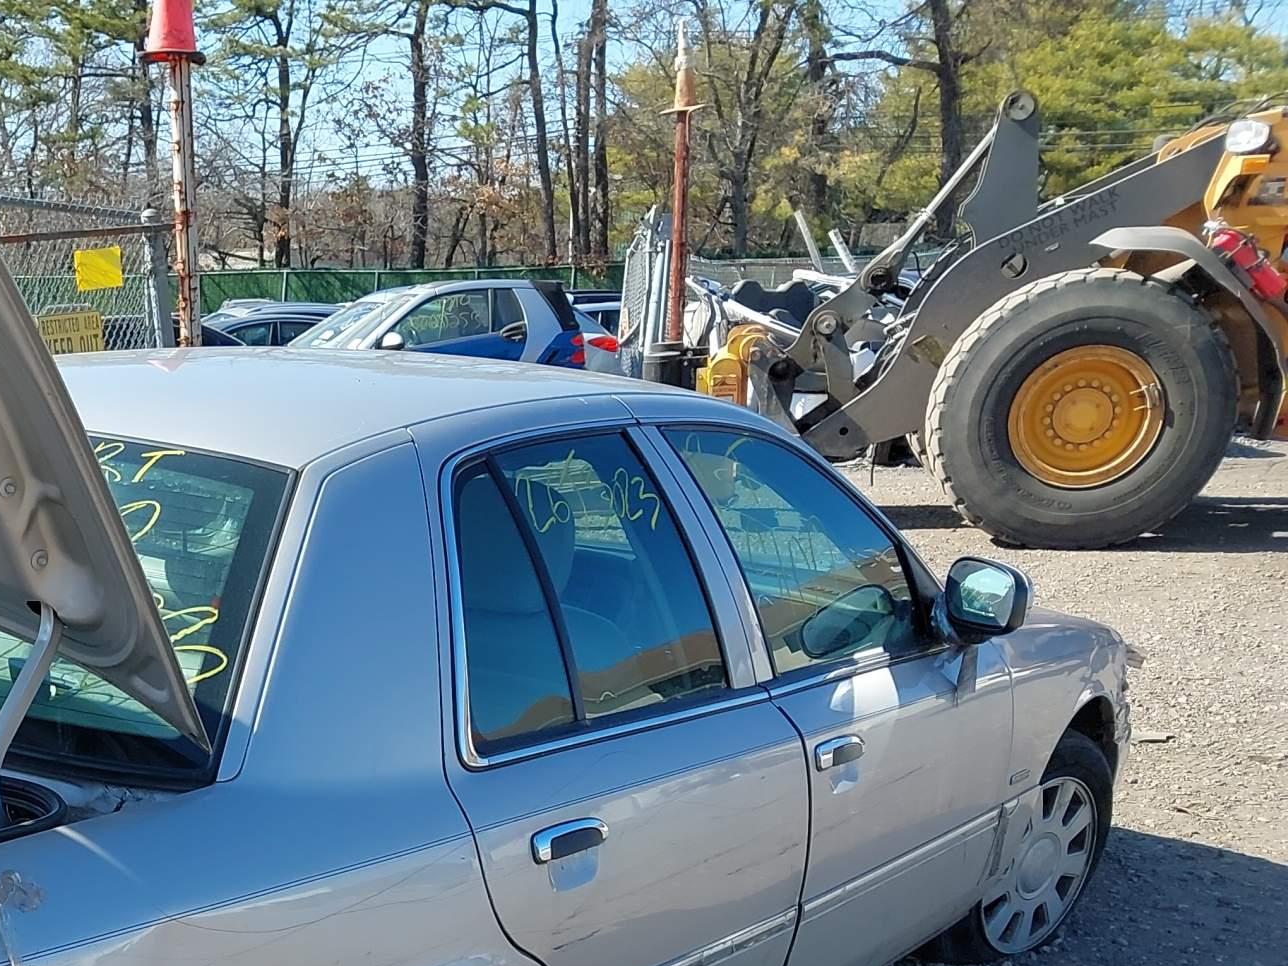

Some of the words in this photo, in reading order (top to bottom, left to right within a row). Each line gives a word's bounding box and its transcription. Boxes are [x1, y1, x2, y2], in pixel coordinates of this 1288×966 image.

[998, 230, 1023, 249] DO
[1029, 214, 1064, 234] NOT
[1069, 187, 1120, 216] WALK
[1012, 223, 1070, 253] UNDER
[1073, 200, 1118, 228] MAST
[41, 317, 80, 336] RESTRICTED
[83, 314, 100, 330] AREA
[79, 333, 99, 352] OUT
